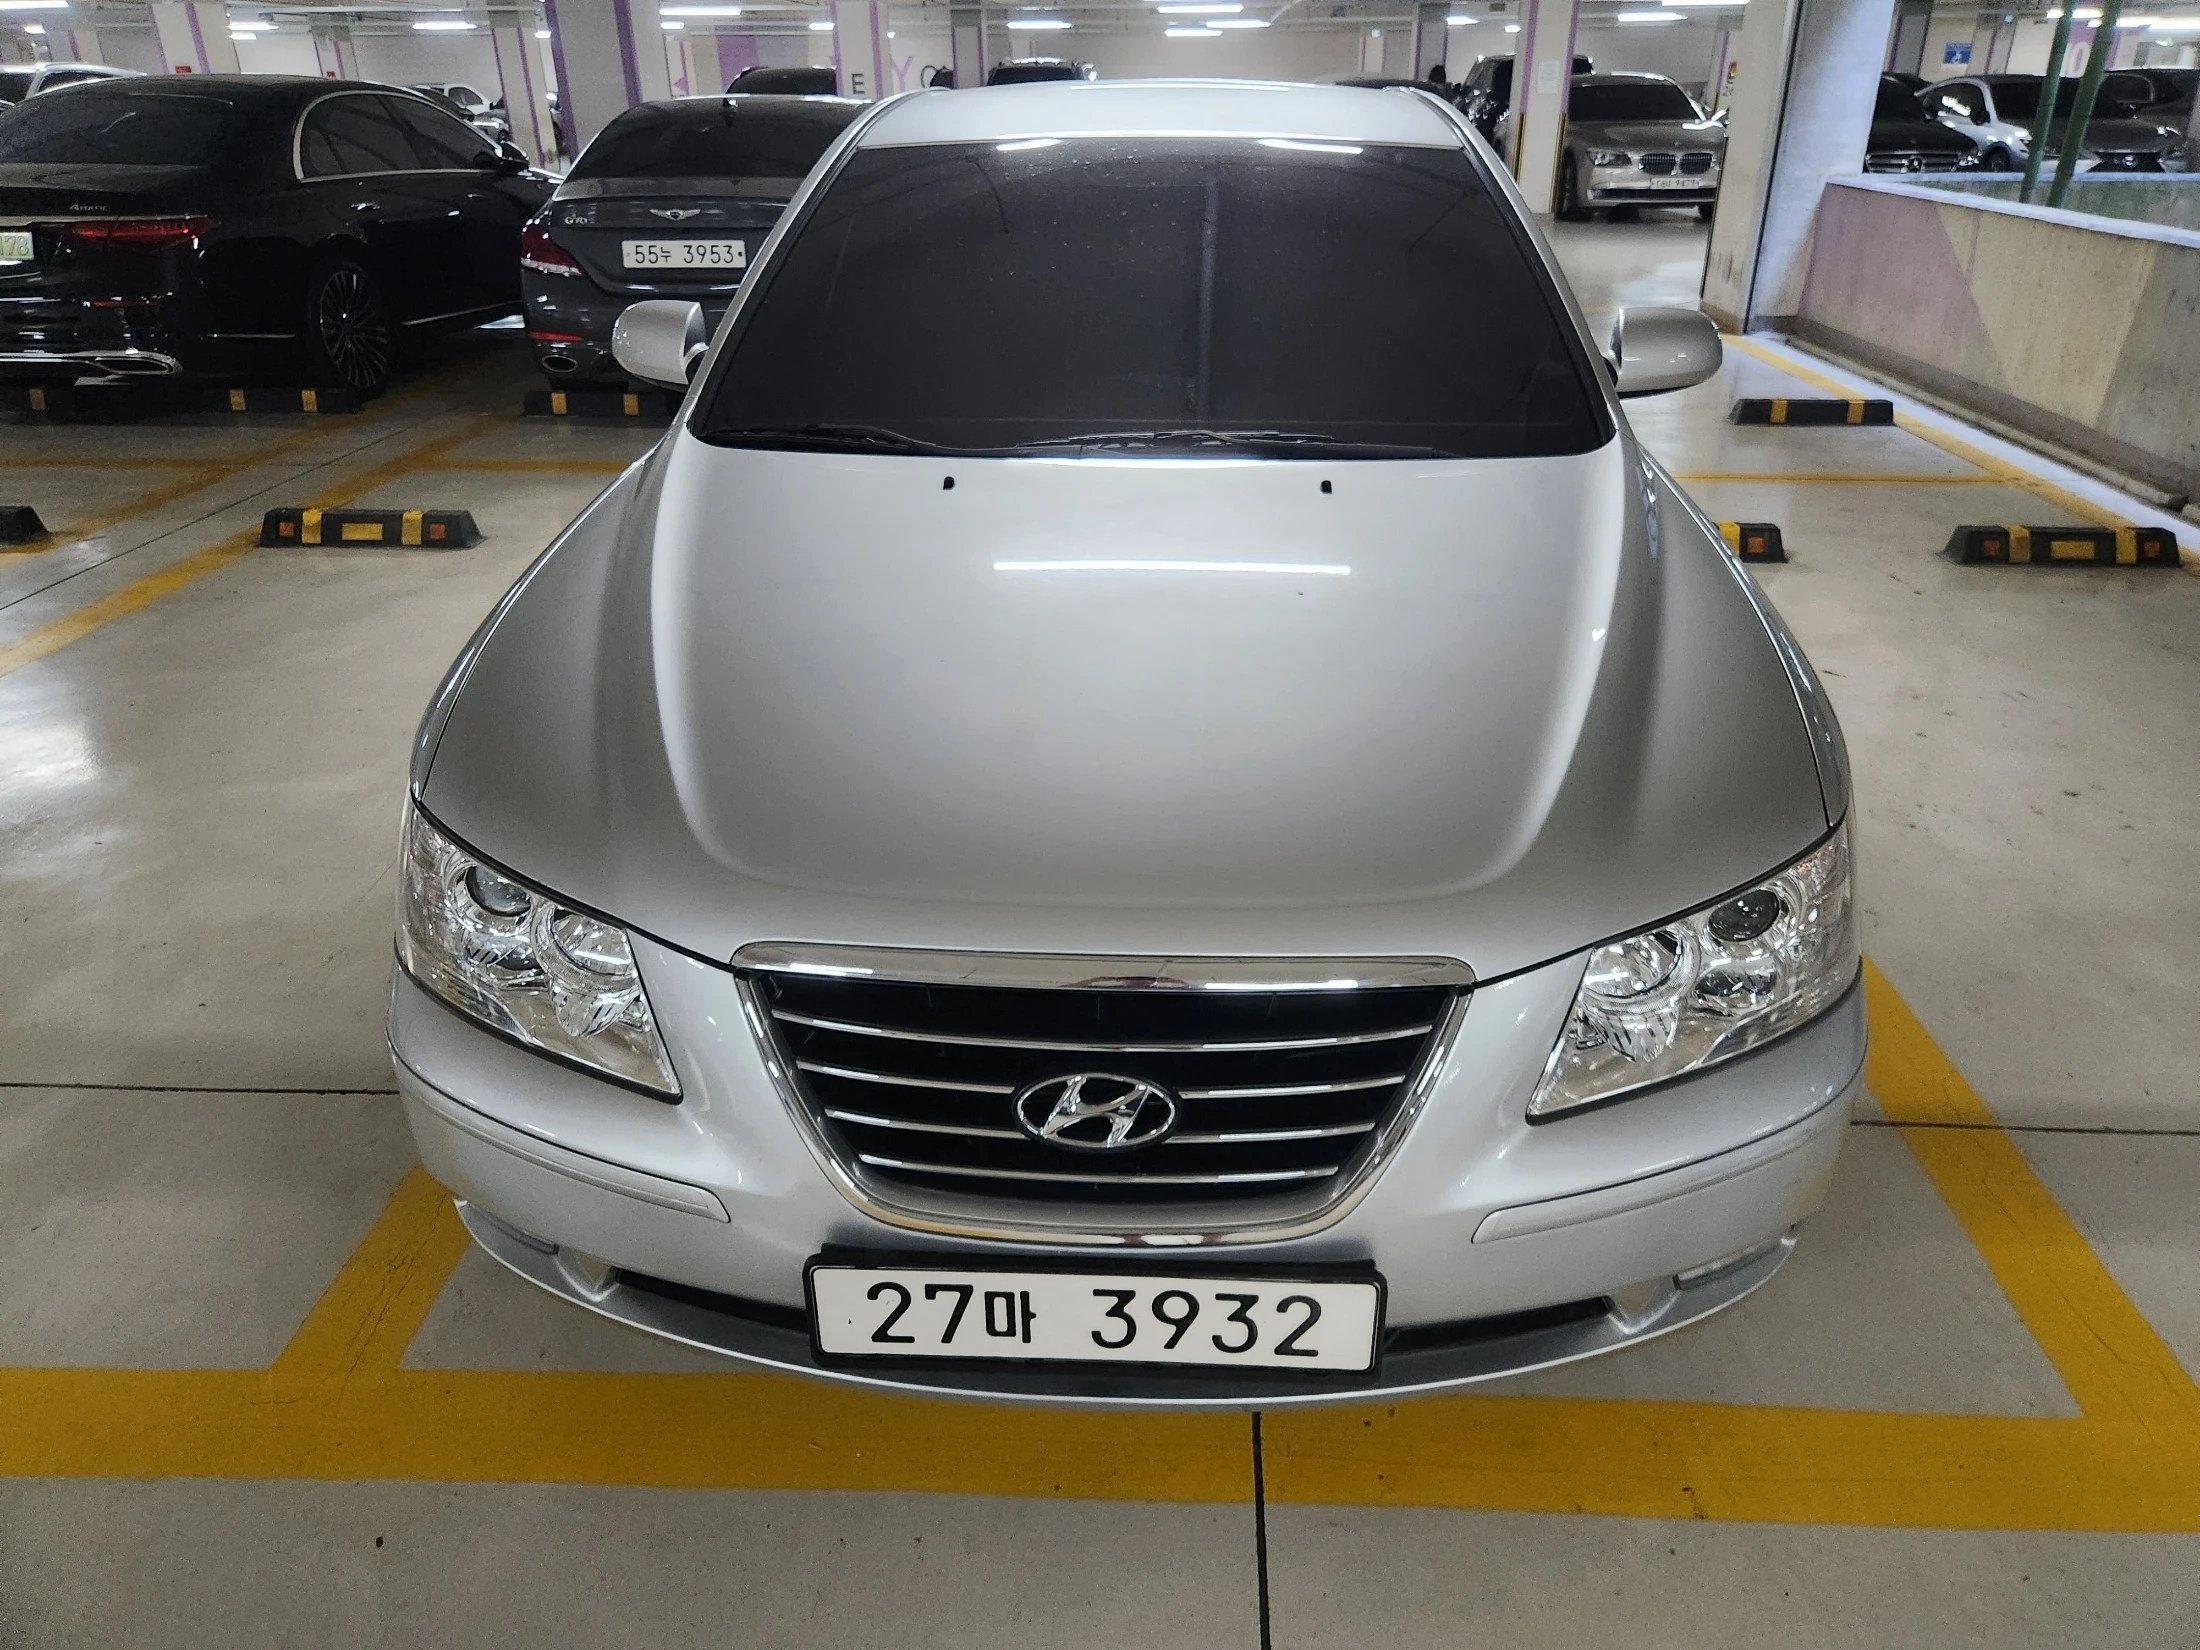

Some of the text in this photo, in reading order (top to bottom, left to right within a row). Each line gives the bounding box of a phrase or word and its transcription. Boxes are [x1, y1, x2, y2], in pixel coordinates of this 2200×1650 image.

[851, 73, 865, 95] E
[635, 245, 734, 264] 55누 3953
[866, 1281, 1322, 1357] 27마 3932
